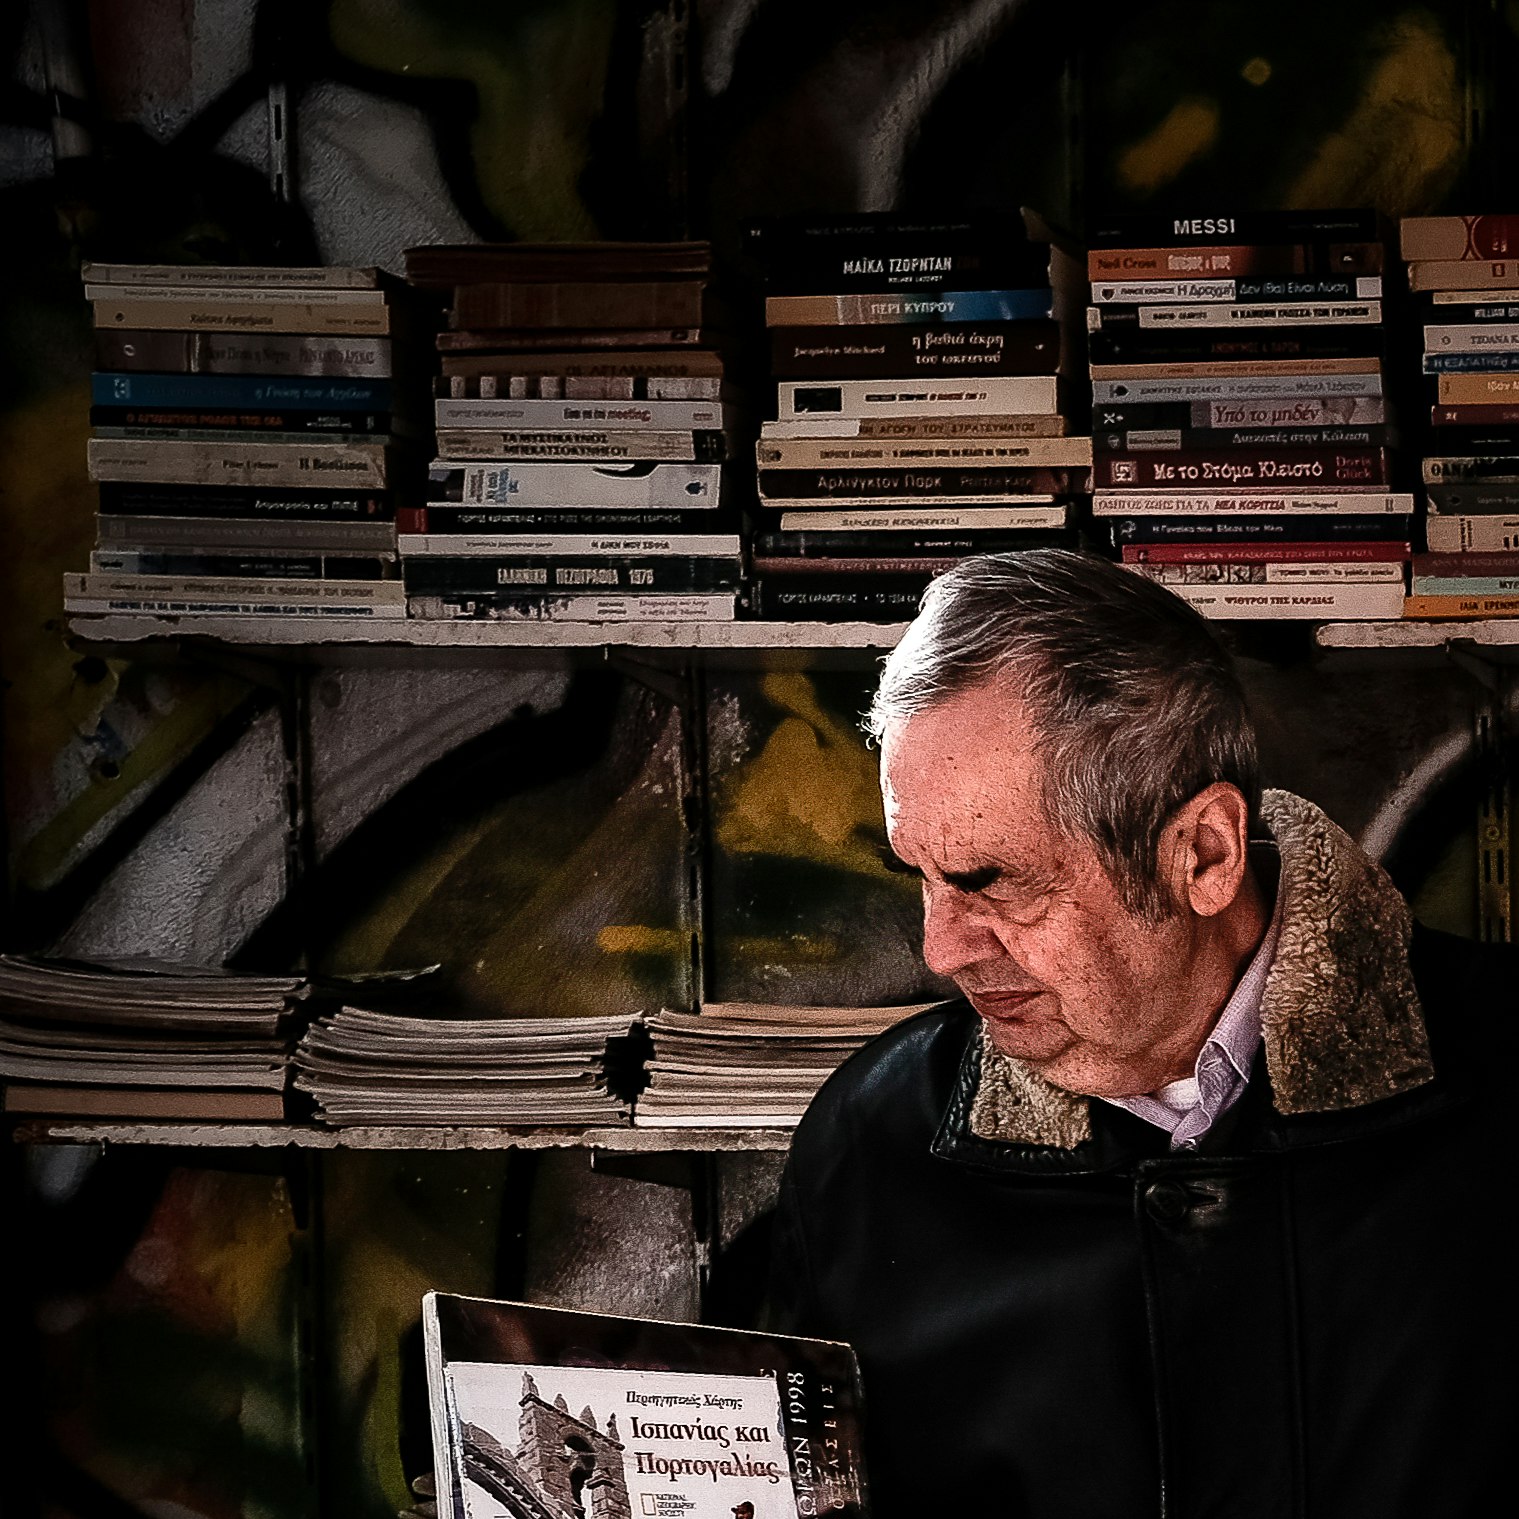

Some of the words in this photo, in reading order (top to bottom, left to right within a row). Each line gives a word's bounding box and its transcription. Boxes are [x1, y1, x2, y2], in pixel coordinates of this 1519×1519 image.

[1173, 218, 1236, 235] MESSI
[1250, 410, 1267, 422] το
[1271, 406, 1320, 423] μηδέν
[1178, 466, 1198, 478] το
[1202, 461, 1254, 482] Στόμα
[787, 1371, 807, 1425] 1998
[630, 1417, 730, 1448] Ισπανίας
[735, 1426, 770, 1443] και
[634, 1452, 779, 1484] Πορτογαλίας
